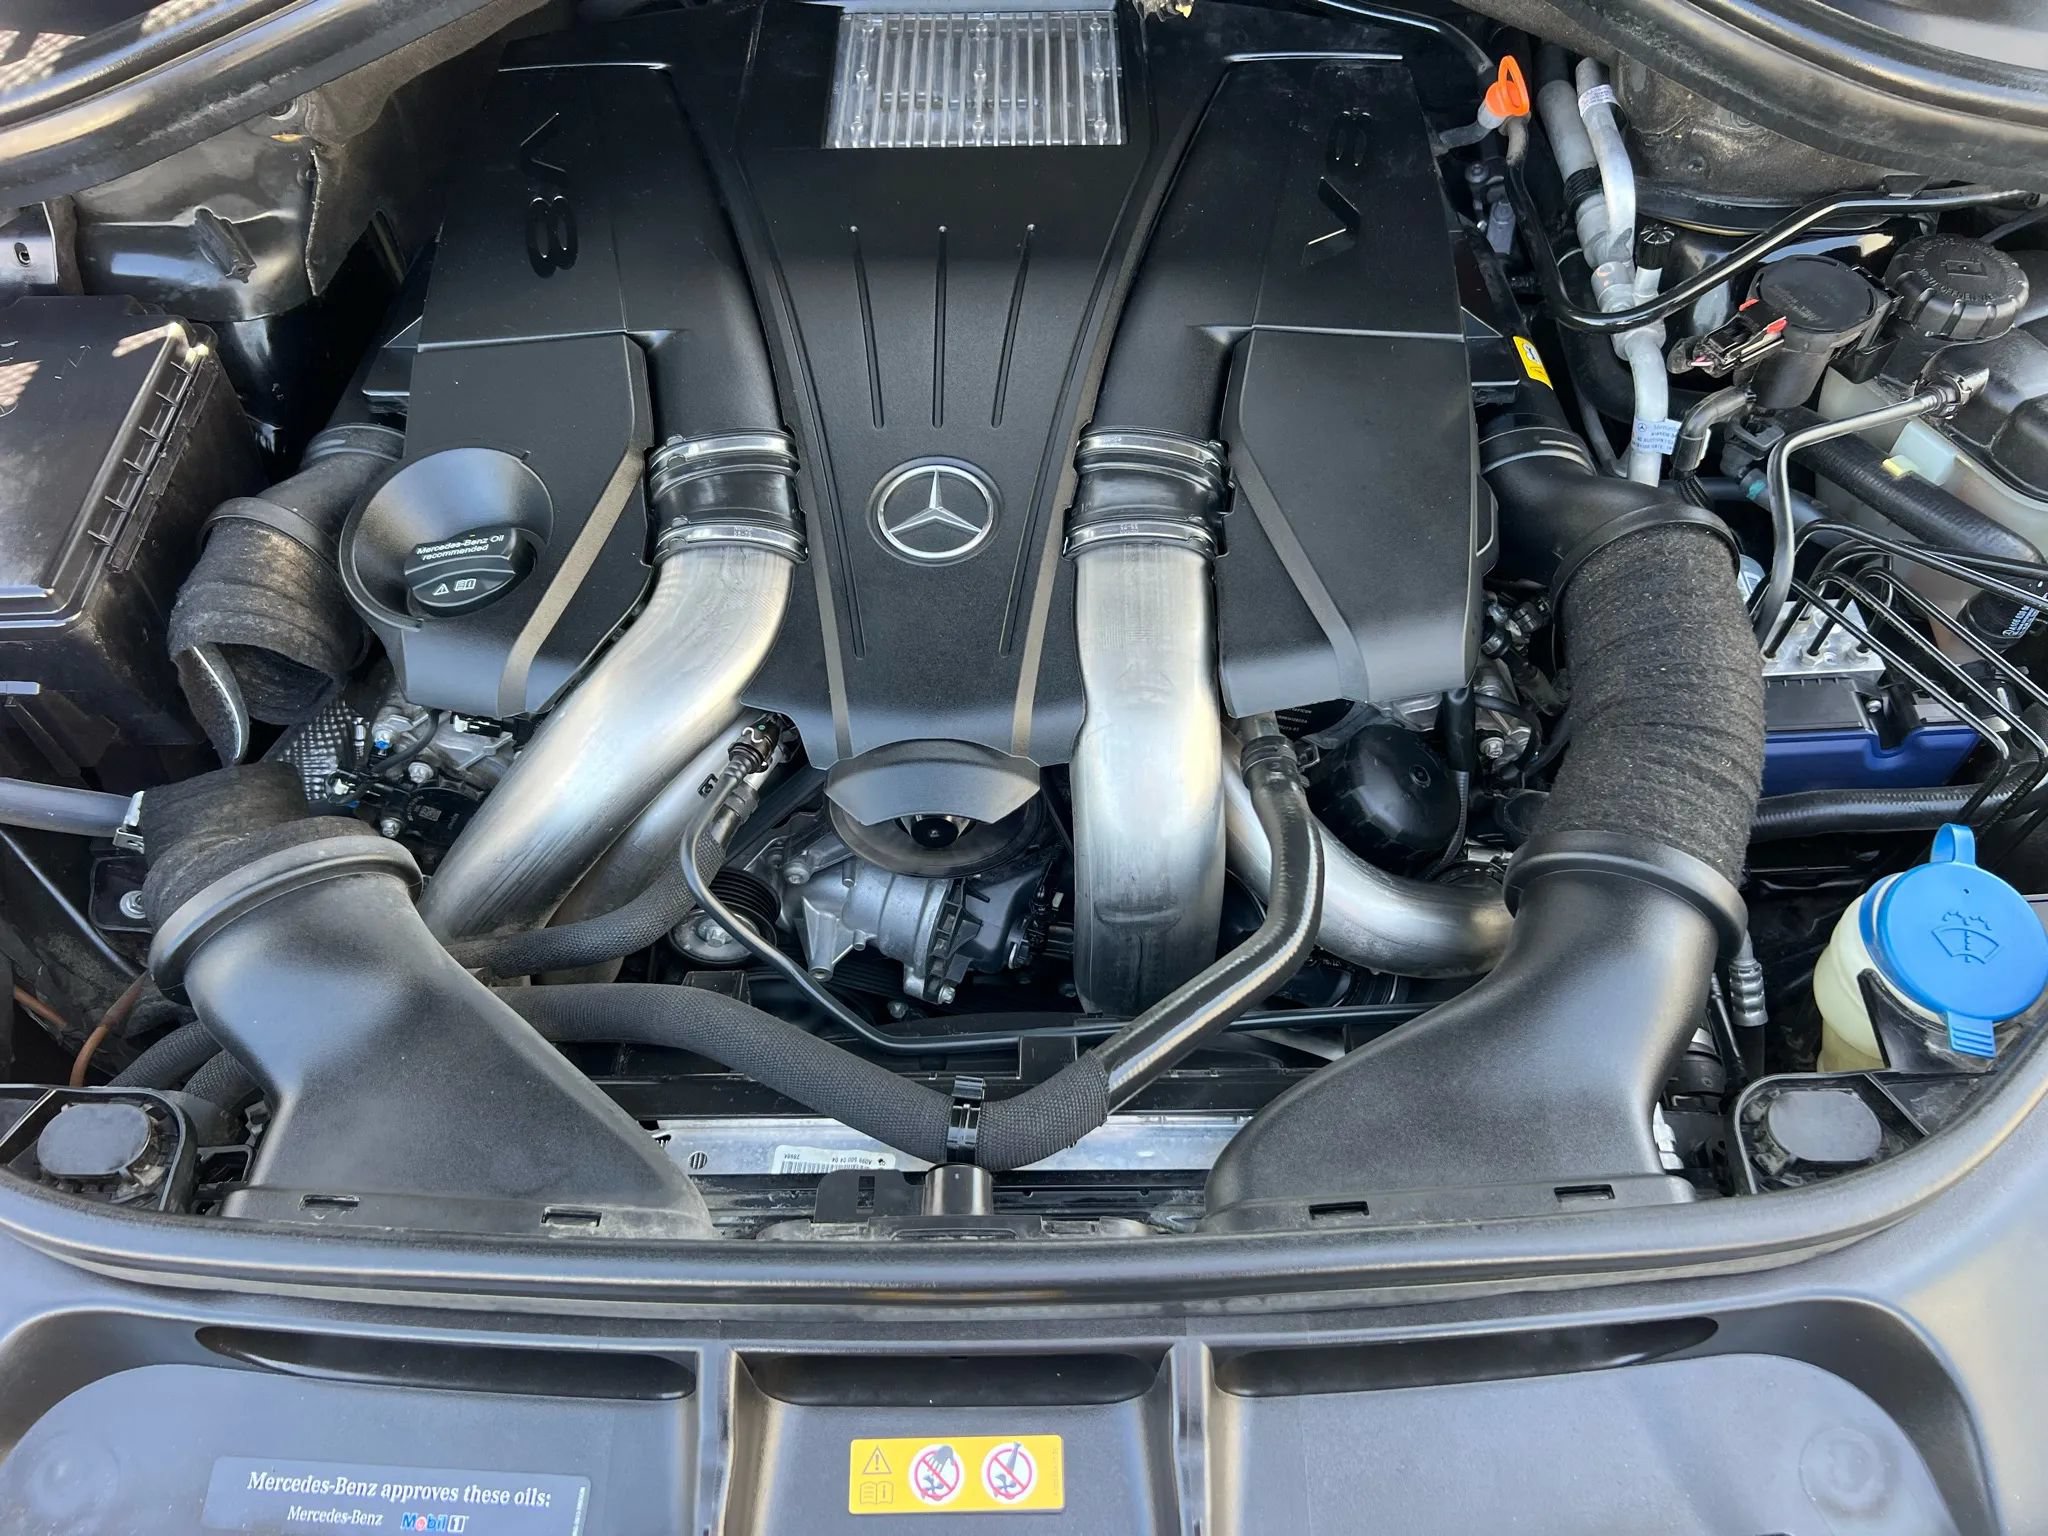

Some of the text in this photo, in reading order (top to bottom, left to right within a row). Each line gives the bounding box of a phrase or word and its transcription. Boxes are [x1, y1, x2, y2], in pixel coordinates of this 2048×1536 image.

[416, 534, 505, 556] Mercedes-Benz Oil
[422, 543, 489, 561] recommended
[247, 1471, 552, 1508] Mercedes-Benz approves these oils:
[287, 1504, 384, 1526] Mercedes-Benz
[400, 1511, 448, 1532] Mobil
